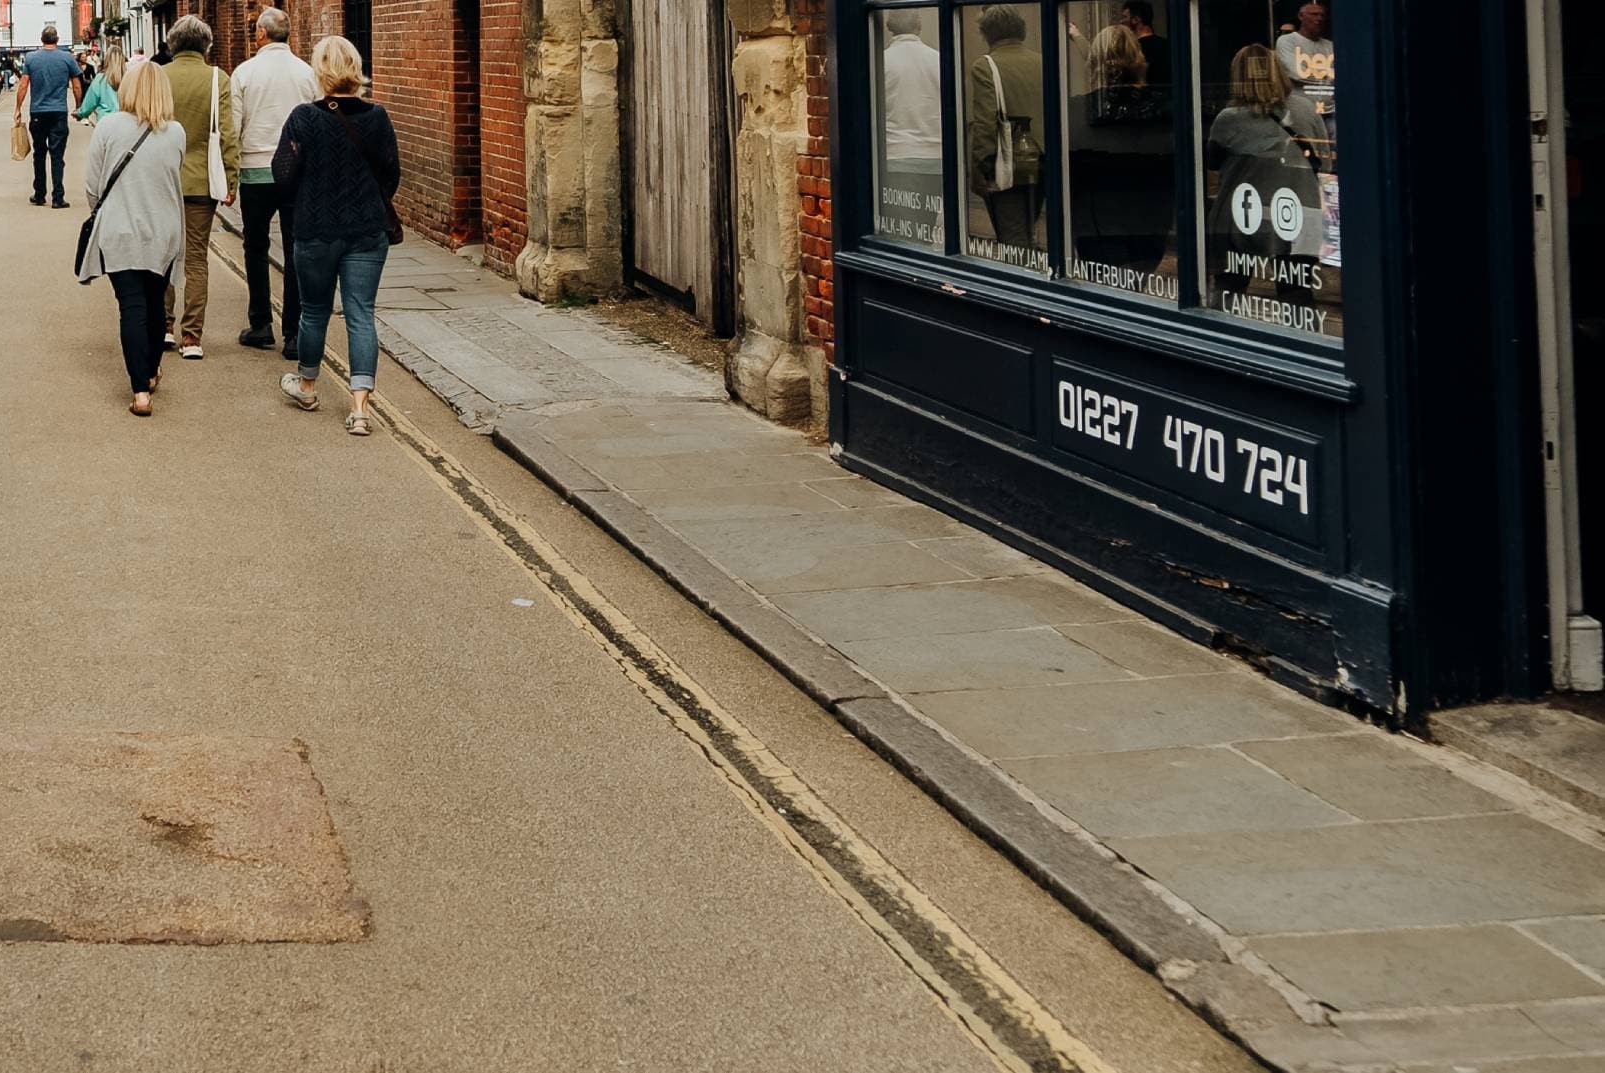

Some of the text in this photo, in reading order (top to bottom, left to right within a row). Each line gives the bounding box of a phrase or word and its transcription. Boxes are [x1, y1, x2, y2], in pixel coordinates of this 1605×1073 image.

[882, 187, 943, 214] BOOKINGS AND
[915, 222, 944, 244] WELCO
[1222, 290, 1327, 334] CANTERBURY
[1059, 380, 1308, 514] 01227 470 724
